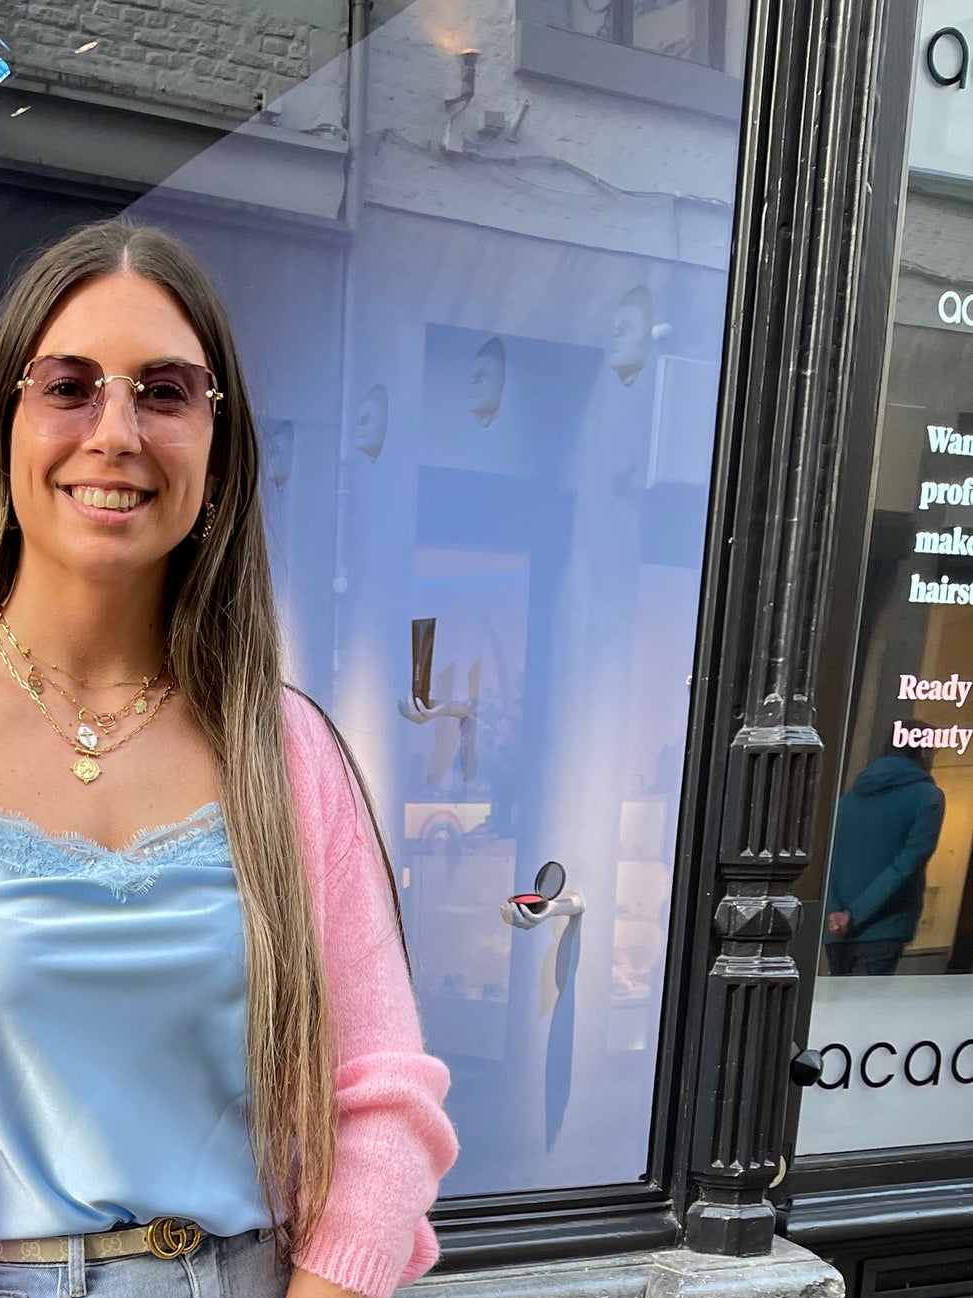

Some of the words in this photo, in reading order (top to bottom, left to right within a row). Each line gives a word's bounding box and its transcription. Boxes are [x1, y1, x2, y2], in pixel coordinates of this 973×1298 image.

[918, 477, 973, 511] prof
[897, 673, 973, 708] Ready
[892, 720, 973, 755] beauty
